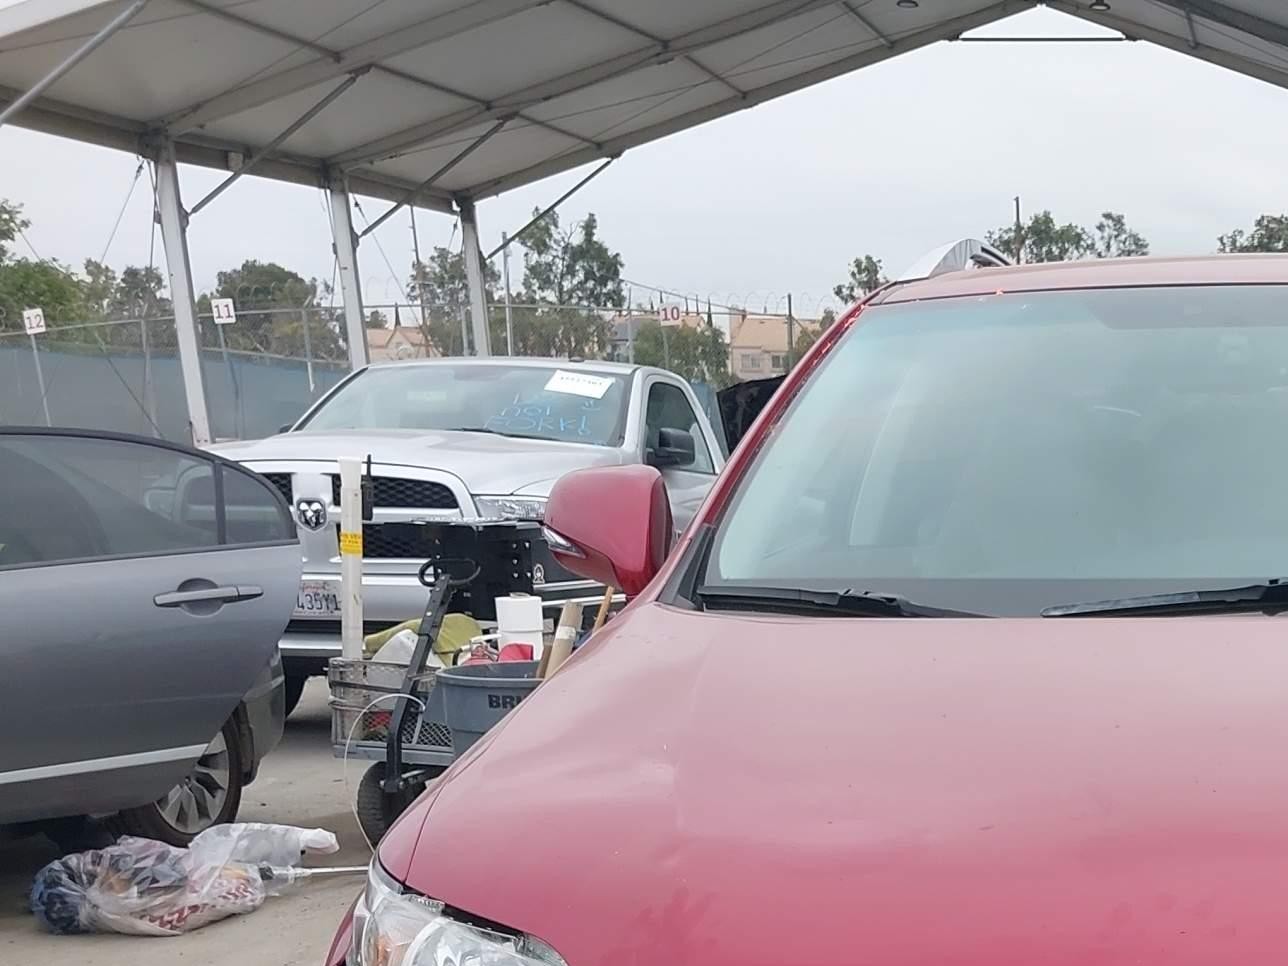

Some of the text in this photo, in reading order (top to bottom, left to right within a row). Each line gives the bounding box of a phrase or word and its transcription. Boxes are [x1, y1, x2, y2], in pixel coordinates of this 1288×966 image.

[214, 304, 233, 319] 11
[661, 306, 680, 321] 10
[26, 313, 44, 329] 12
